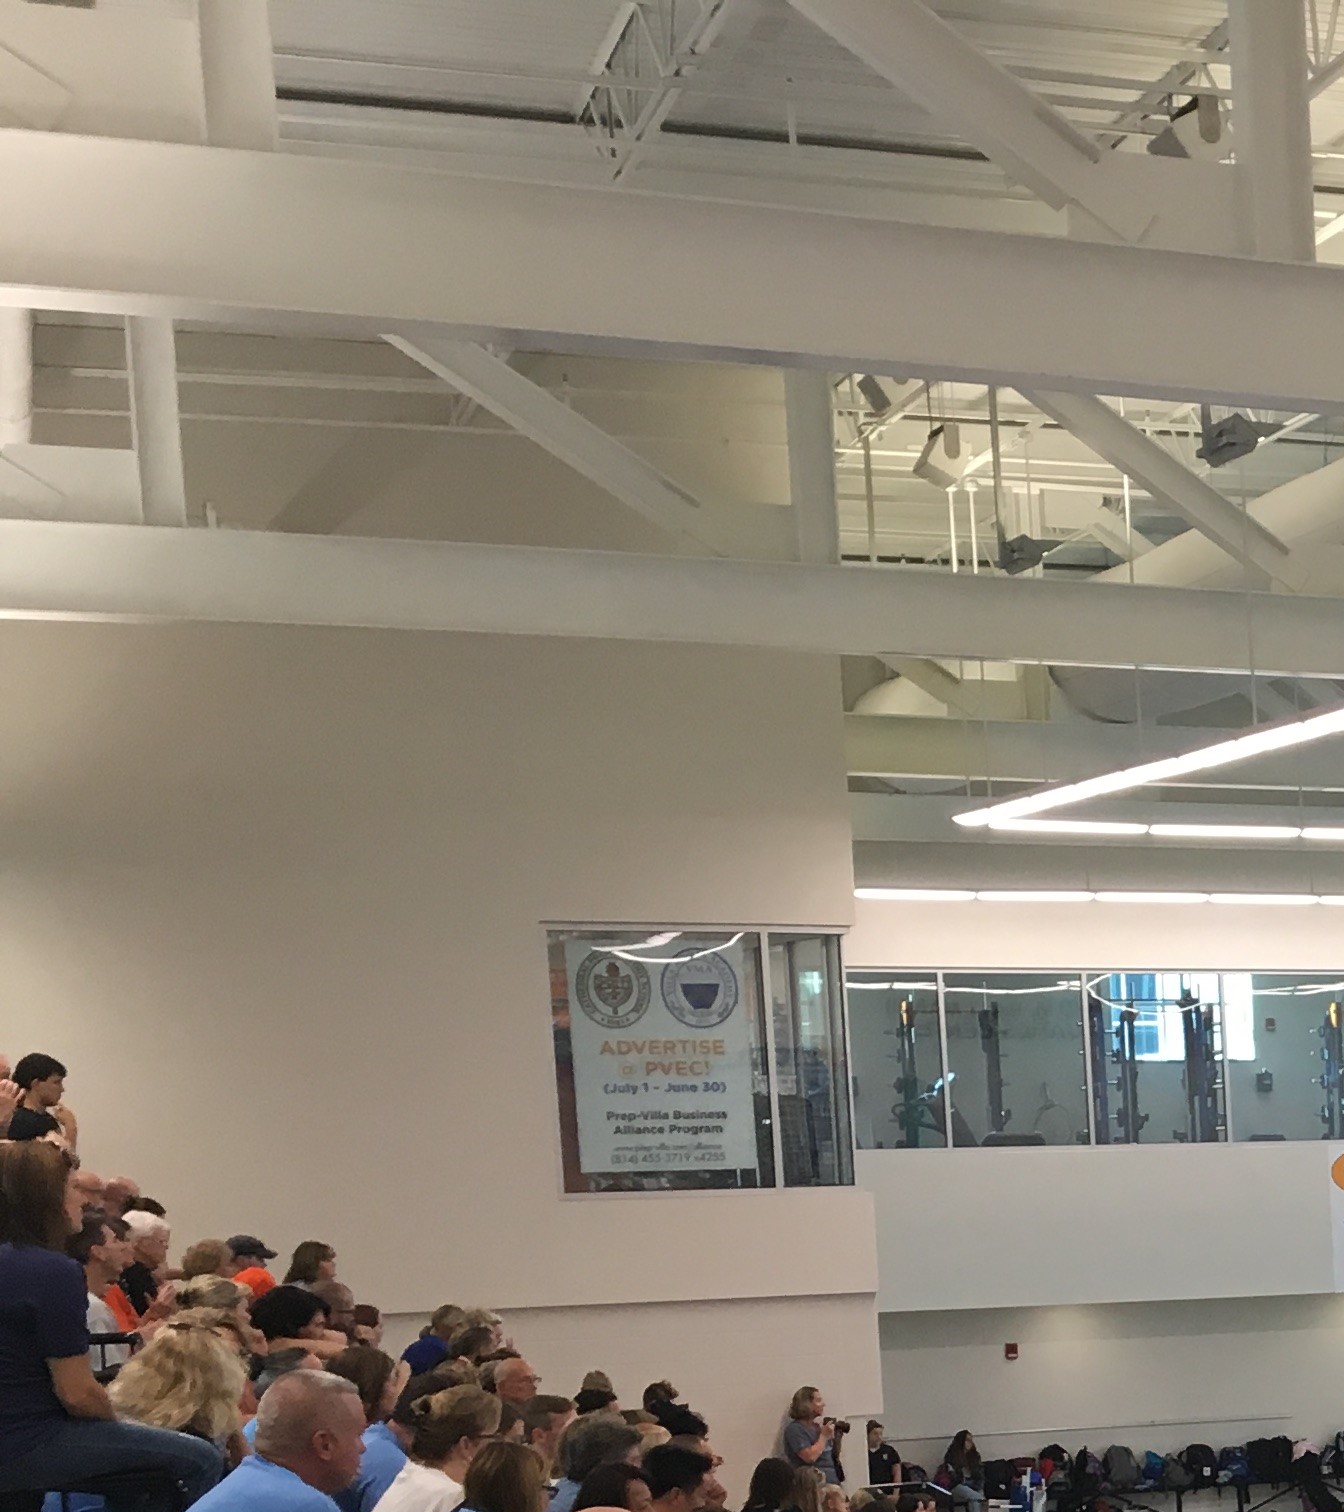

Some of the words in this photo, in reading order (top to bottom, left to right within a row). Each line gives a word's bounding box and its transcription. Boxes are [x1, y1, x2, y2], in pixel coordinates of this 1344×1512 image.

[600, 1039, 726, 1056] ADVERTISE
[618, 1061, 637, 1079] @
[645, 1060, 713, 1076] PVEC!
[603, 1082, 638, 1096] (July
[642, 1082, 649, 1094] 1
[663, 1081, 699, 1094] June
[702, 1081, 728, 1094] 30)
[605, 1109, 670, 1122] Prep-Villa
[672, 1109, 728, 1121] Business
[613, 1124, 665, 1135] Alliance
[668, 1124, 724, 1136] Program
